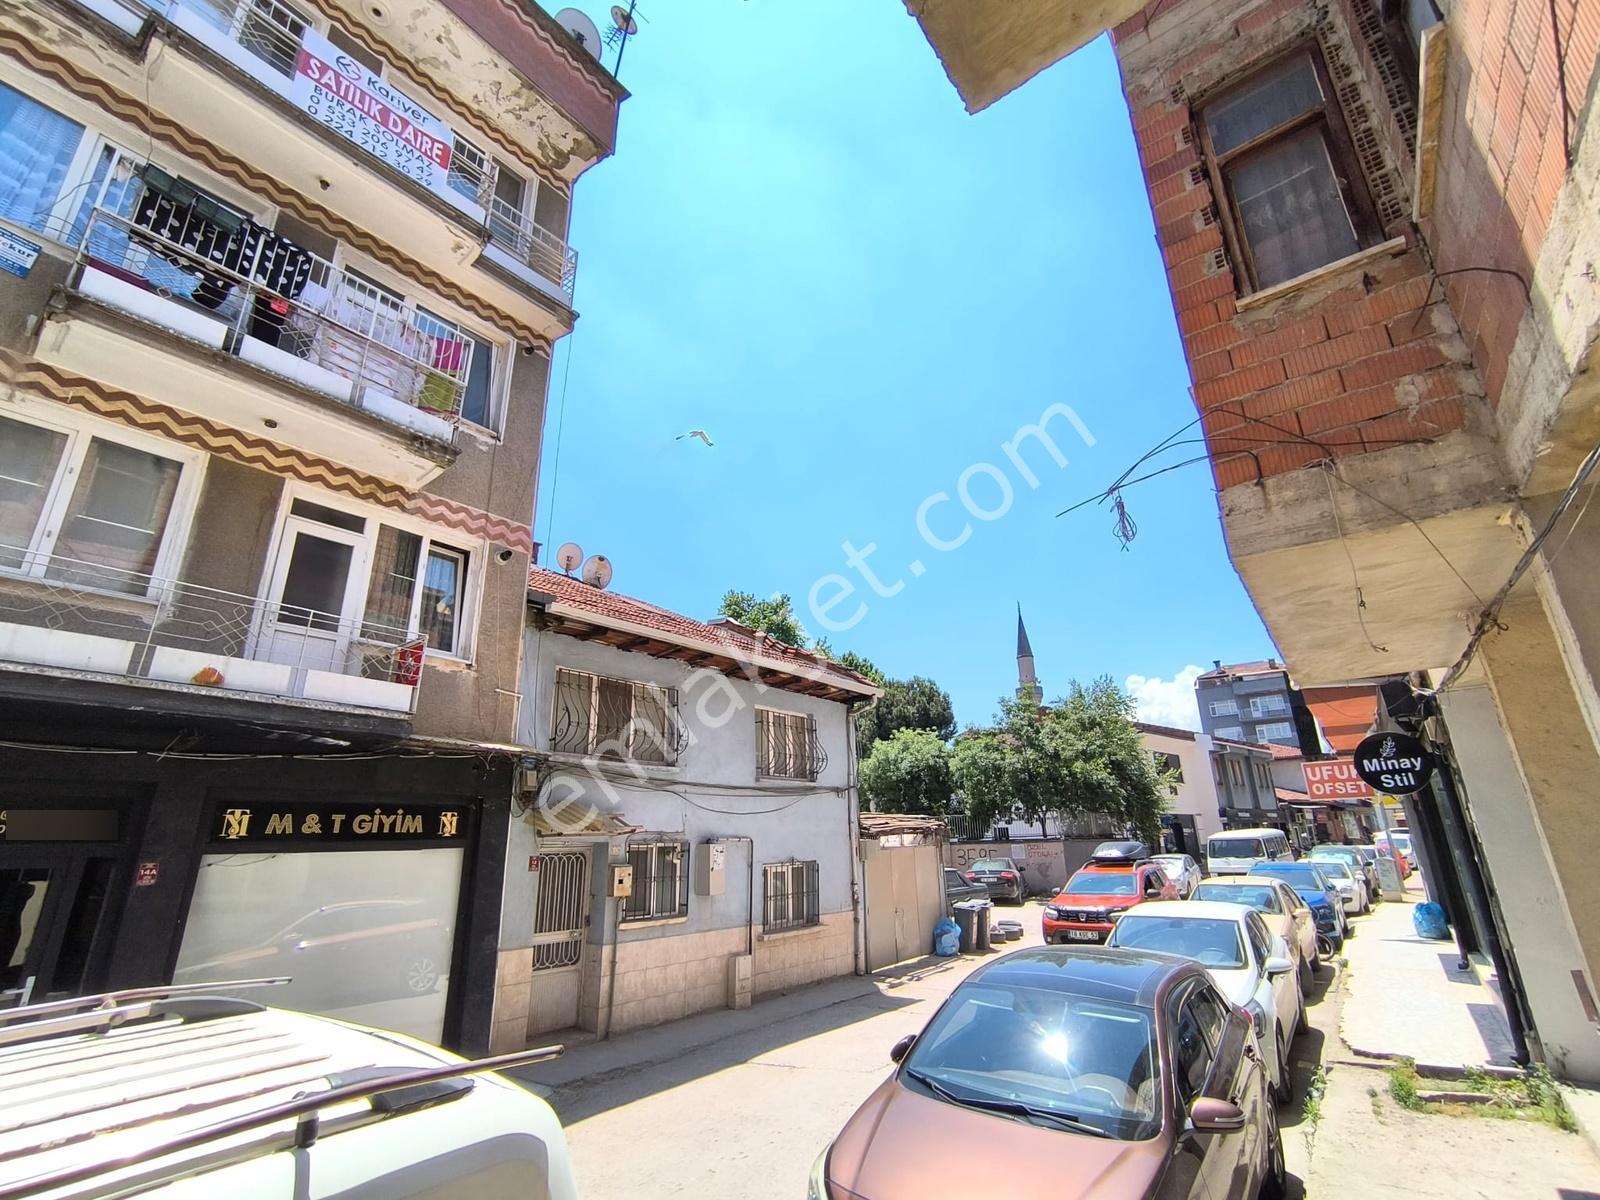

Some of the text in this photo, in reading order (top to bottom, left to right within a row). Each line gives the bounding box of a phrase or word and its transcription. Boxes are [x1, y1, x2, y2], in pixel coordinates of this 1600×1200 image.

[307, 58, 383, 122] SATILIK
[367, 77, 429, 125] Kariyer
[308, 105, 318, 115] 0
[323, 115, 354, 138] 224
[360, 137, 387, 158] 712
[310, 95, 320, 105] 0
[326, 105, 356, 128] 533
[362, 127, 388, 150] 206
[395, 149, 411, 163] 97
[314, 84, 368, 126] BURAK
[374, 123, 433, 170] SOLMAZ
[1312, 781, 1367, 795] OFSET
[1363, 757, 1421, 772] Minay
[1380, 772, 1415, 788] Stil
[264, 813, 293, 834] M
[301, 814, 322, 834] &
[331, 814, 346, 833] T
[352, 808, 423, 834] GİYİM
